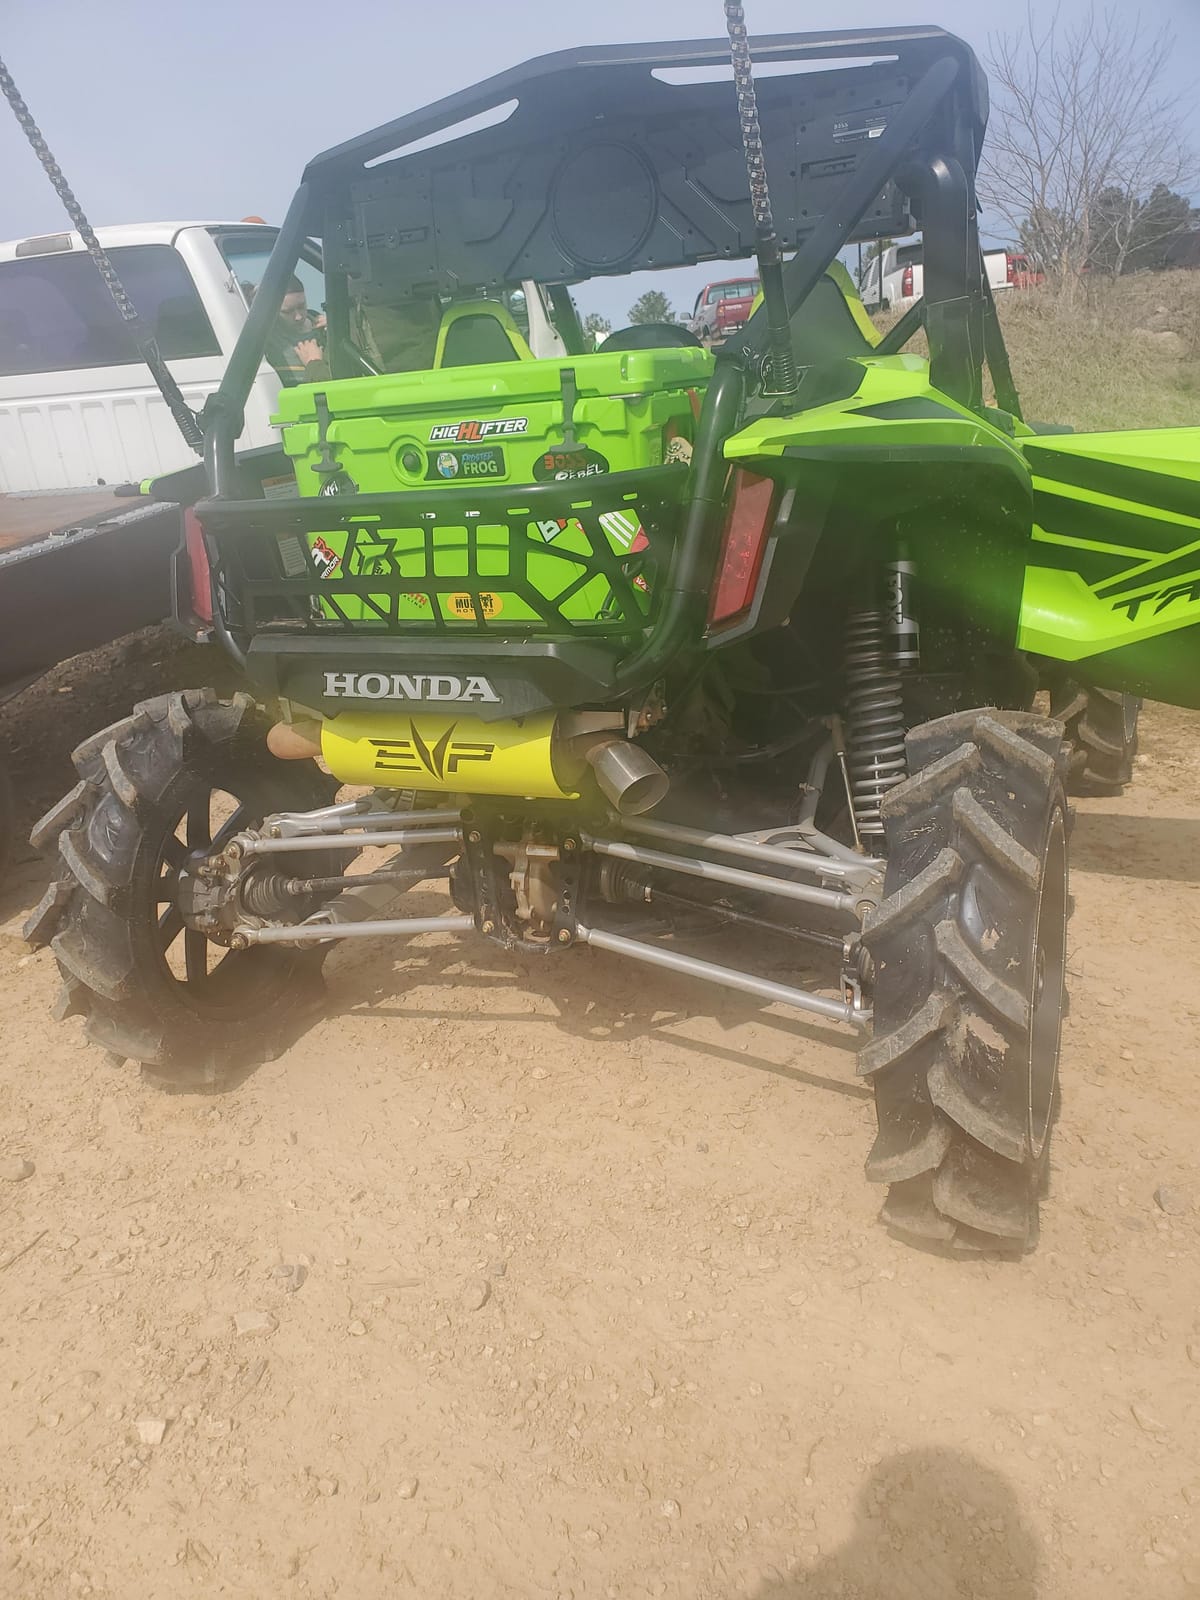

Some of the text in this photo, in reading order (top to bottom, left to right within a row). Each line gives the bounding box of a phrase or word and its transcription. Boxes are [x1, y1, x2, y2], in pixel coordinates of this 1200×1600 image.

[432, 419, 526, 440] HIGHLIFTER
[463, 460, 498, 475] FROG
[323, 672, 501, 703] HONDA
